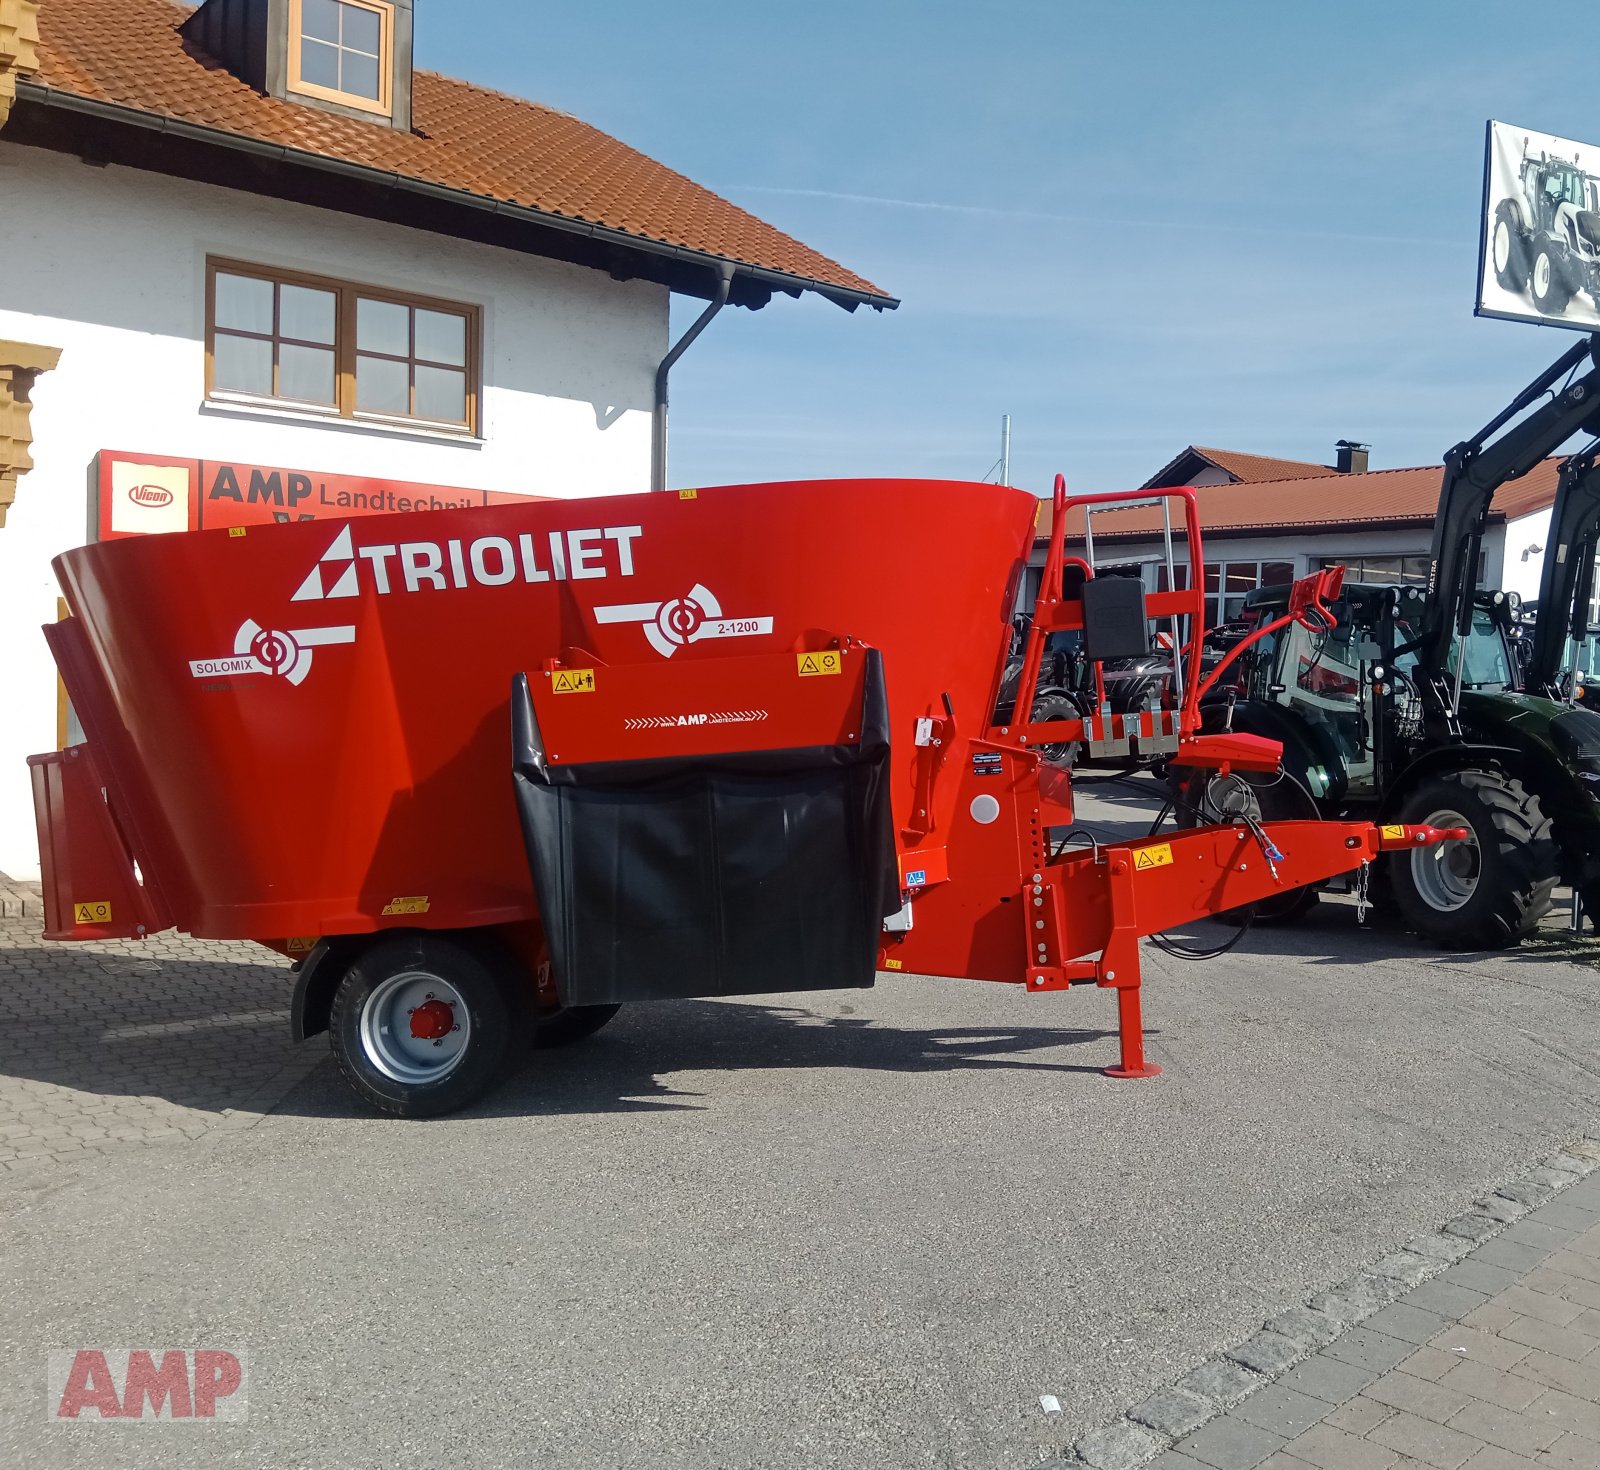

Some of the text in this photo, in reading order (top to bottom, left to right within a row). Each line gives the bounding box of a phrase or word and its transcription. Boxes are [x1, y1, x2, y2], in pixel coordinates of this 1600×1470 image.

[134, 485, 167, 502] Vicon
[208, 466, 313, 508] AMP
[358, 525, 643, 595] TRIOLIET
[1428, 559, 1438, 595] VALTRA
[717, 621, 759, 634] 2-1200
[196, 660, 253, 674] SOLOMIX
